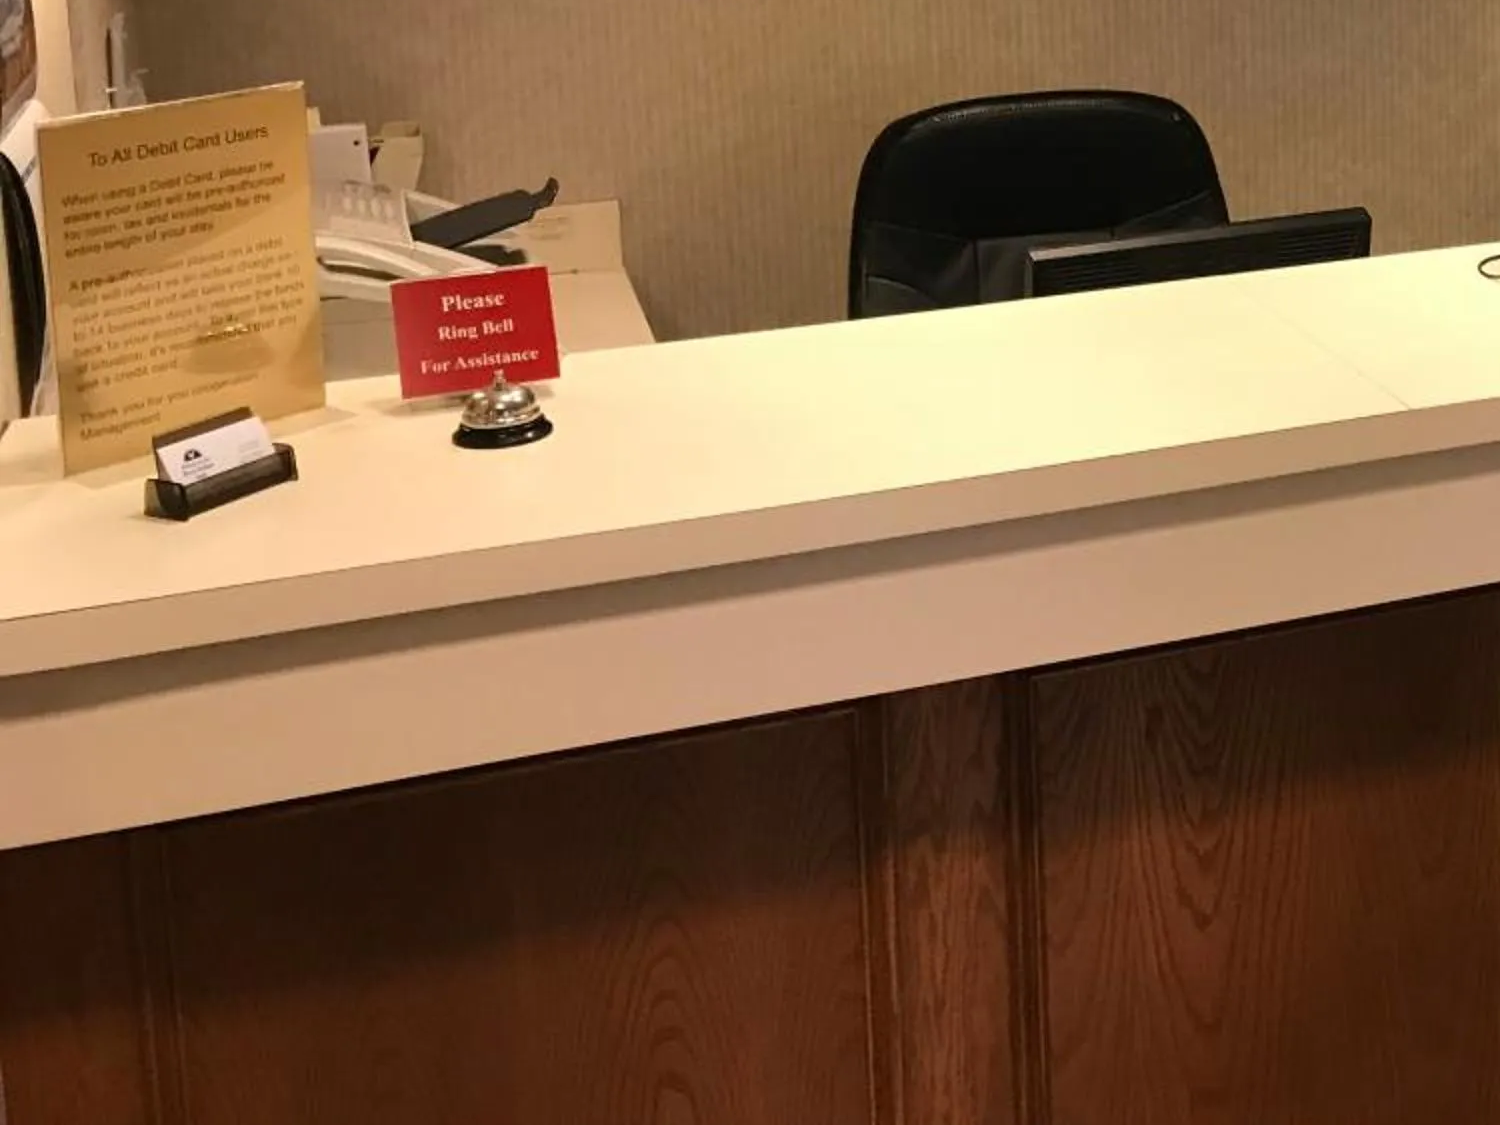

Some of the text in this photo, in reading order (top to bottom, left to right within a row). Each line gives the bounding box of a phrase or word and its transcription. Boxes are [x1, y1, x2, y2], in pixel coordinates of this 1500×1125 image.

[88, 122, 268, 168] To All Debit Card Users
[441, 294, 505, 312] Please
[438, 318, 514, 341] Ring Bell
[420, 349, 540, 374] For Assistance
